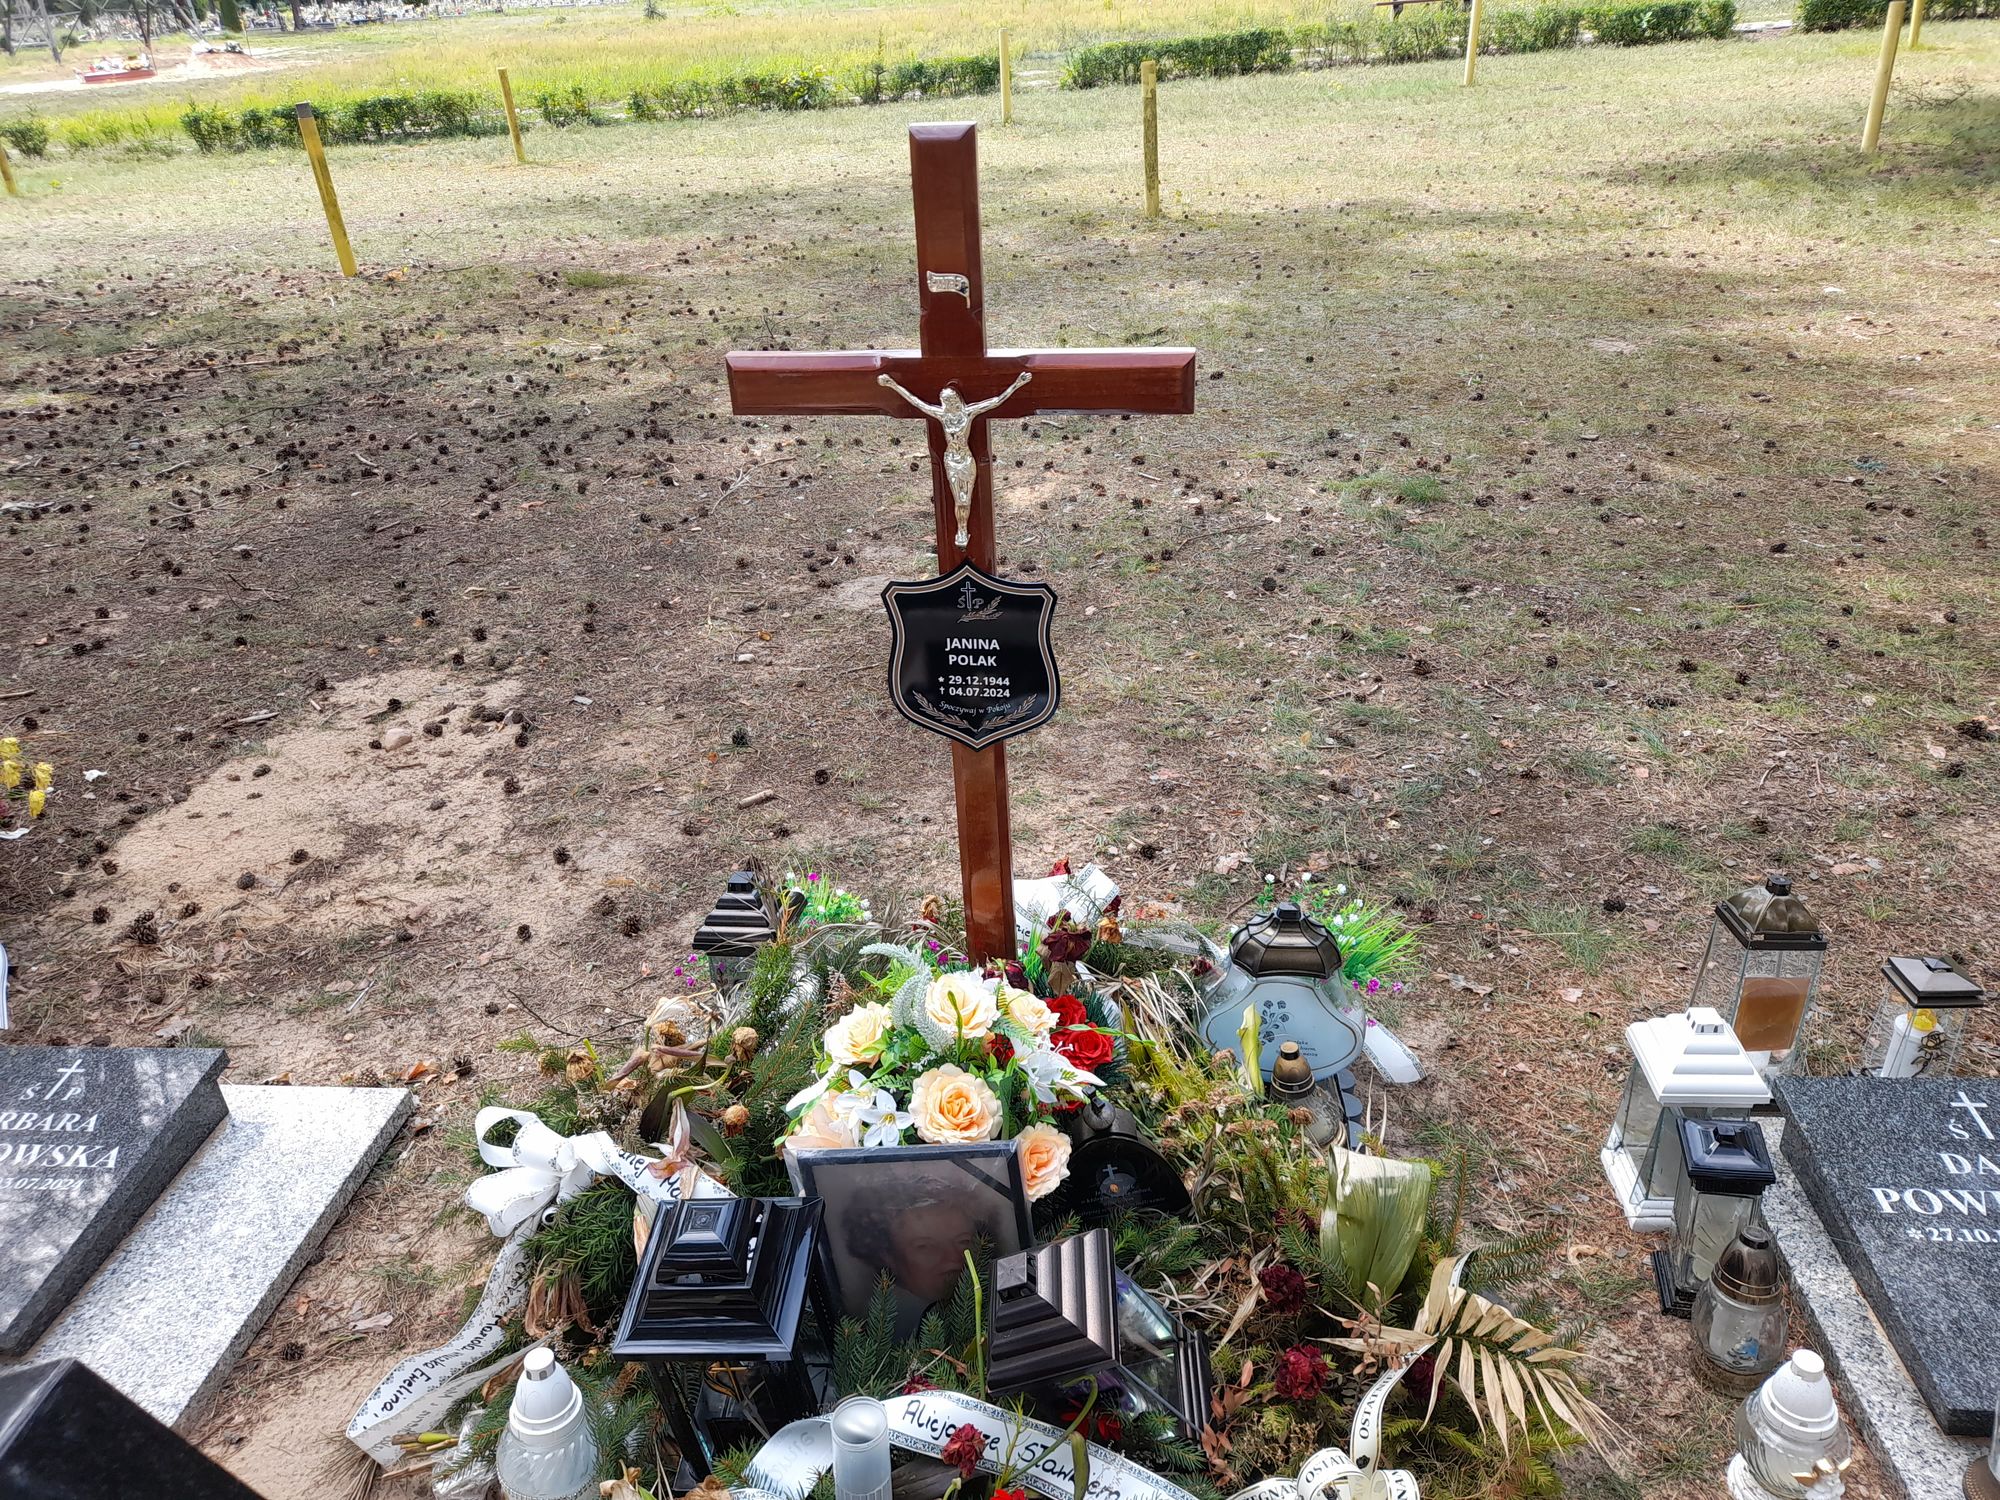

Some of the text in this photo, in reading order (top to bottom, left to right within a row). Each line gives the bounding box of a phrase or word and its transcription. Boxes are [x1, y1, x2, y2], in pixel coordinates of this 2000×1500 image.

[945, 638, 1000, 651] JANINA
[948, 654, 997, 667] POLAK
[948, 675, 1010, 687] 29.12.1944
[949, 687, 1011, 698] 04.07.2024
[939, 701, 977, 717] Spoczywaj
[986, 703, 1011, 713] Pokoju
[20, 1082, 82, 1100] Ś P
[1949, 1118, 1970, 1140] Ś
[1866, 1187, 2000, 1217] POW
[1926, 1227, 2000, 1243] 27.10.
